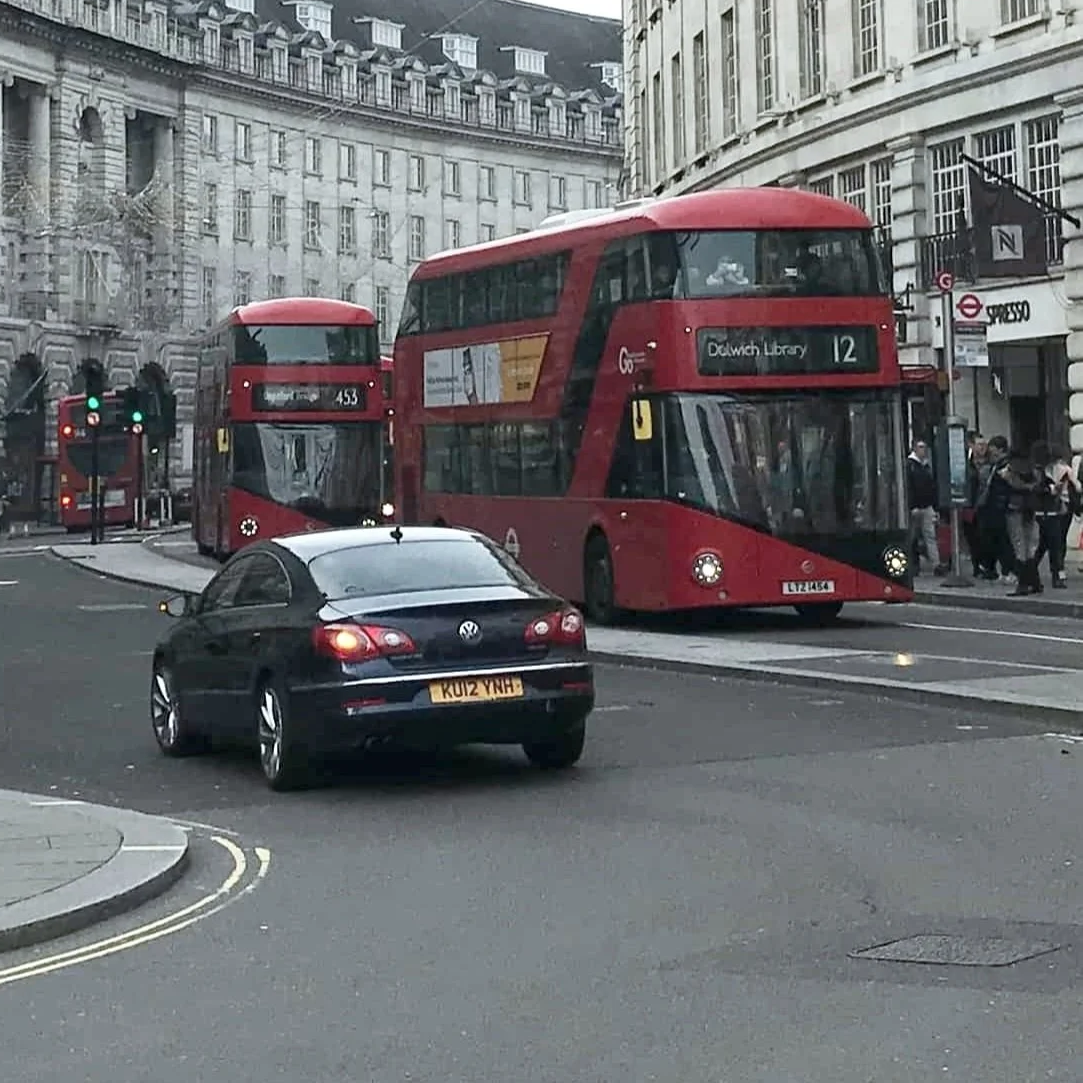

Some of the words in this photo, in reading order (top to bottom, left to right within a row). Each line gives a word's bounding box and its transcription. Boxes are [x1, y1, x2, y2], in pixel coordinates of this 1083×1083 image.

[938, 272, 952, 292] G
[986, 300, 1031, 326] SPRESSO
[763, 338, 808, 360] Library
[833, 334, 858, 363] 12
[335, 387, 358, 406] 453
[440, 680, 479, 699] KU12
[483, 676, 515, 695] YNH
